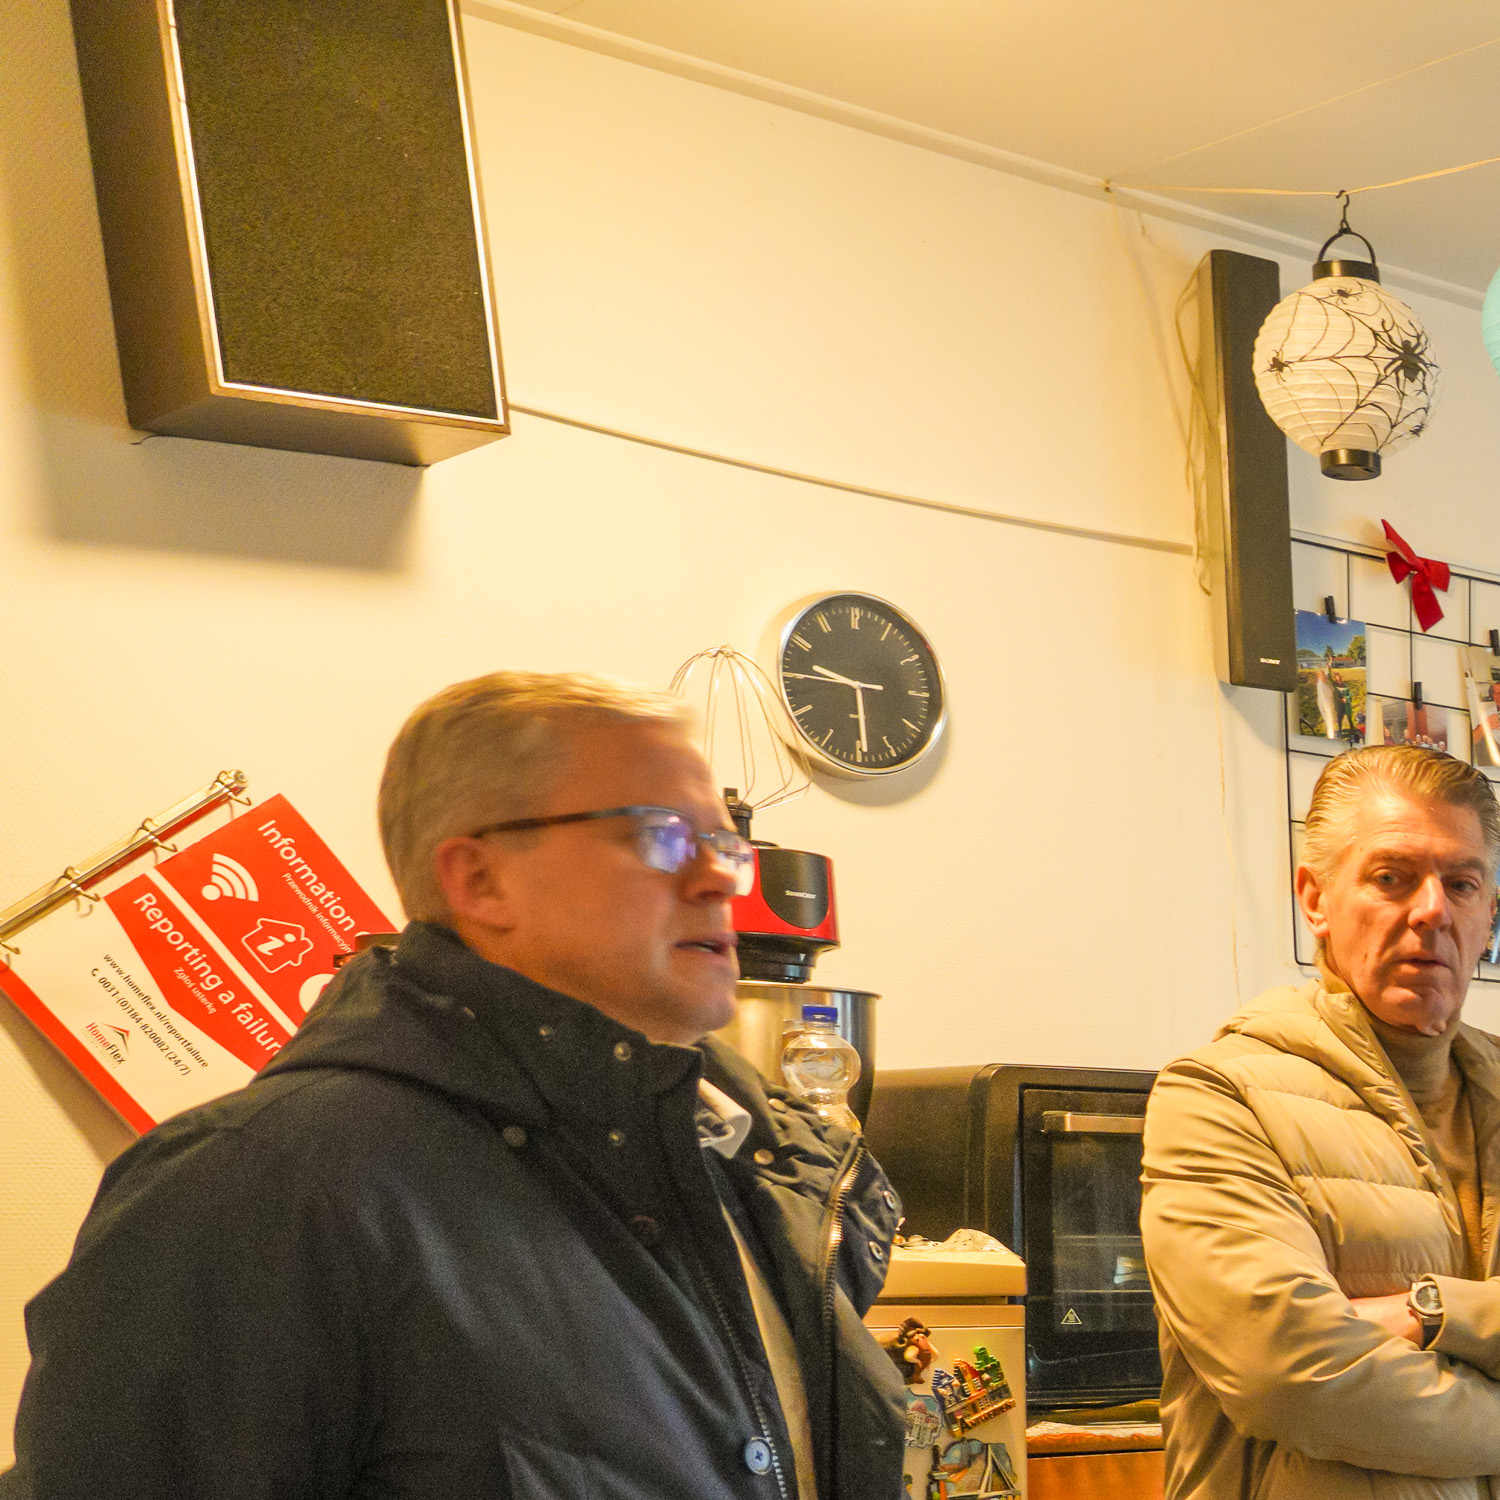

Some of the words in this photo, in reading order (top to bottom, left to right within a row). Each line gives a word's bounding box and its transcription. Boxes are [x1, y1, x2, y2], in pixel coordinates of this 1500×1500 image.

[257, 819, 356, 932] Information
[282, 872, 319, 914] Przewodnik
[315, 912, 352, 953] informacyjn
[103, 954, 209, 1068] www.homeflex.nl/reportfailure
[133, 892, 224, 991] Reporting
[217, 990, 236, 1005] a
[231, 1002, 282, 1056] failur
[85, 1022, 126, 1065] HomeFlex
[164, 1051, 192, 1076] (24/7)
